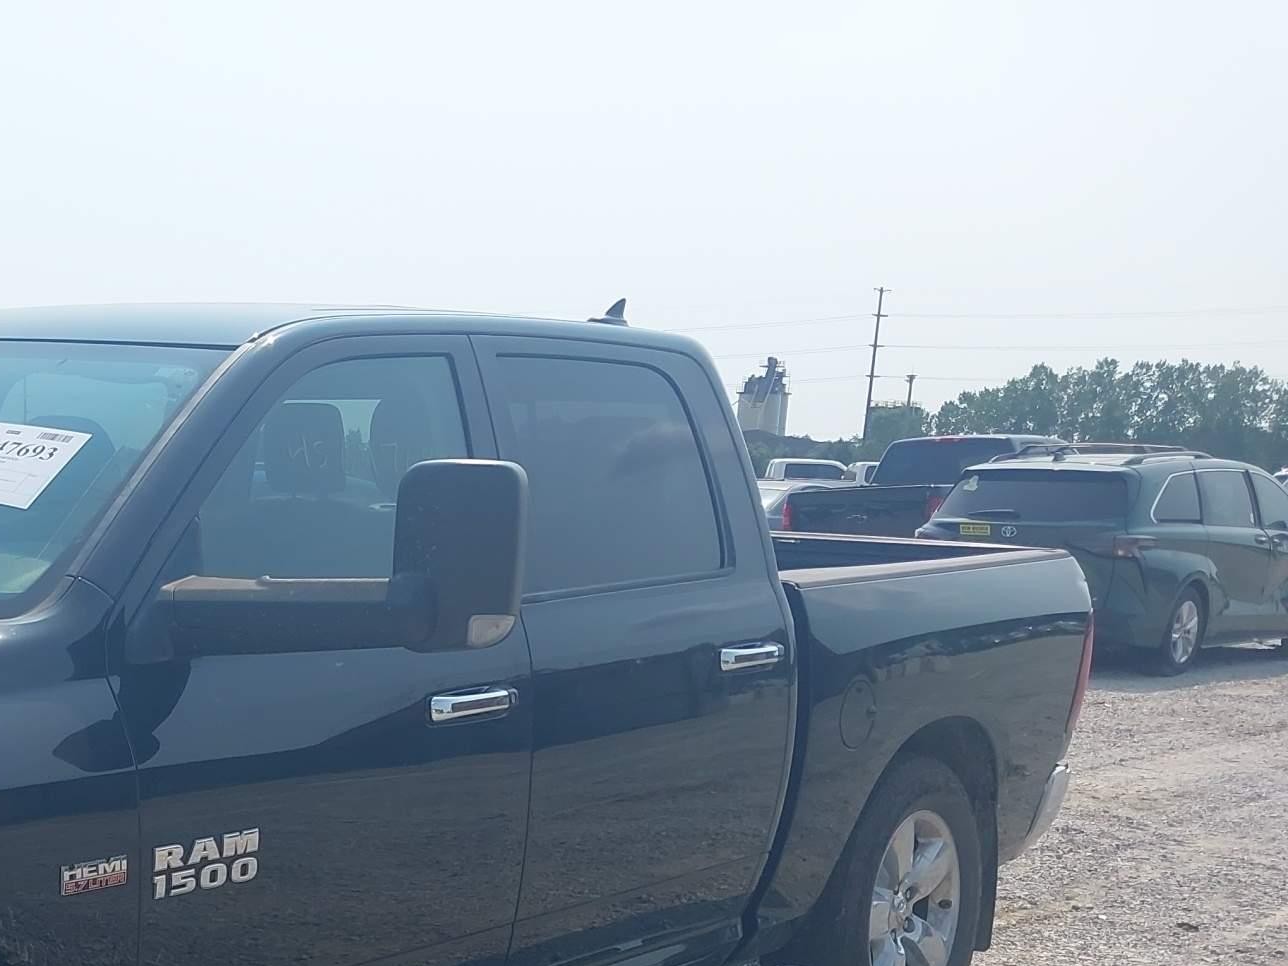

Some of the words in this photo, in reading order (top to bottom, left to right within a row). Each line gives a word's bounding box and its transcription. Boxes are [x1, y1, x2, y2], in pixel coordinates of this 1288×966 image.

[61, 855, 127, 881] HEMI
[153, 828, 259, 872] RAM
[152, 857, 259, 900] 1500
